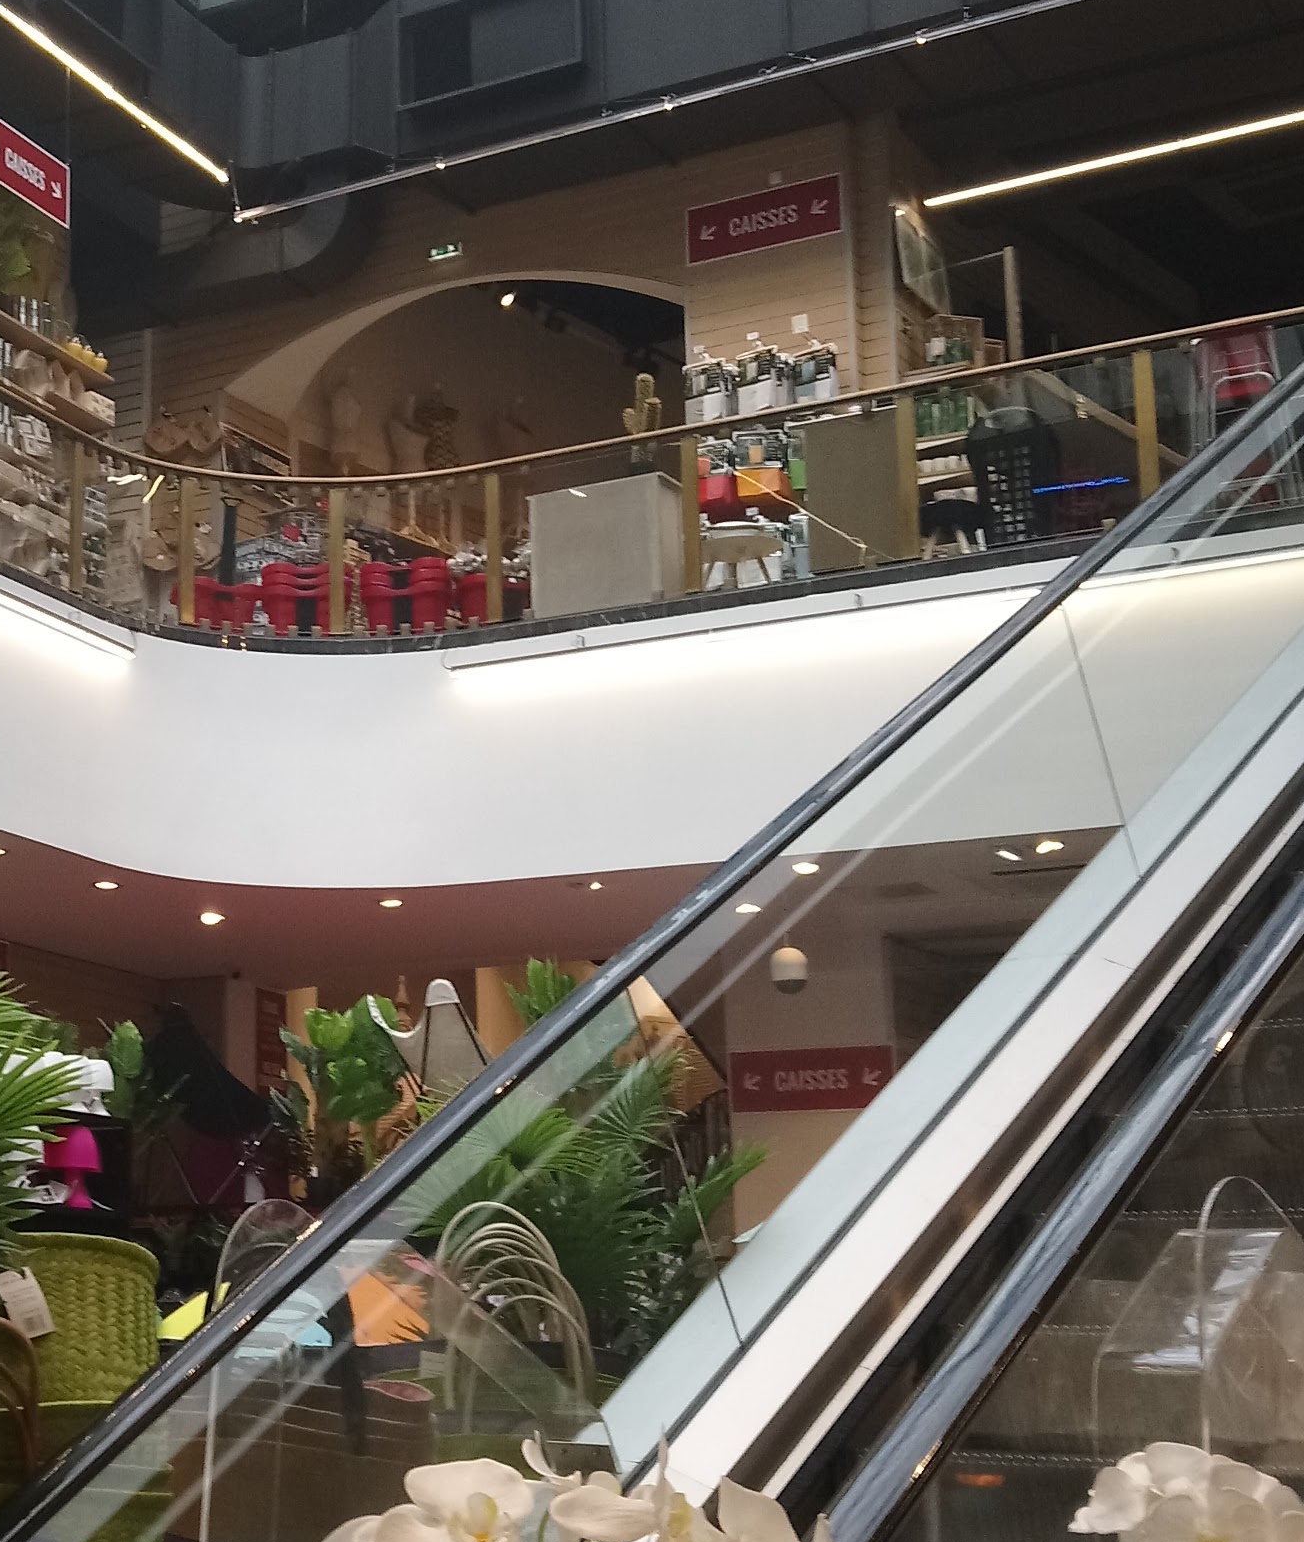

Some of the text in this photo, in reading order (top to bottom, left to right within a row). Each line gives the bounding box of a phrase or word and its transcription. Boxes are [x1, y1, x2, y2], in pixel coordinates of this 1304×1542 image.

[4, 146, 46, 191] CAISSES
[728, 204, 799, 237] CAISSES
[774, 1067, 849, 1093] CAISSES
